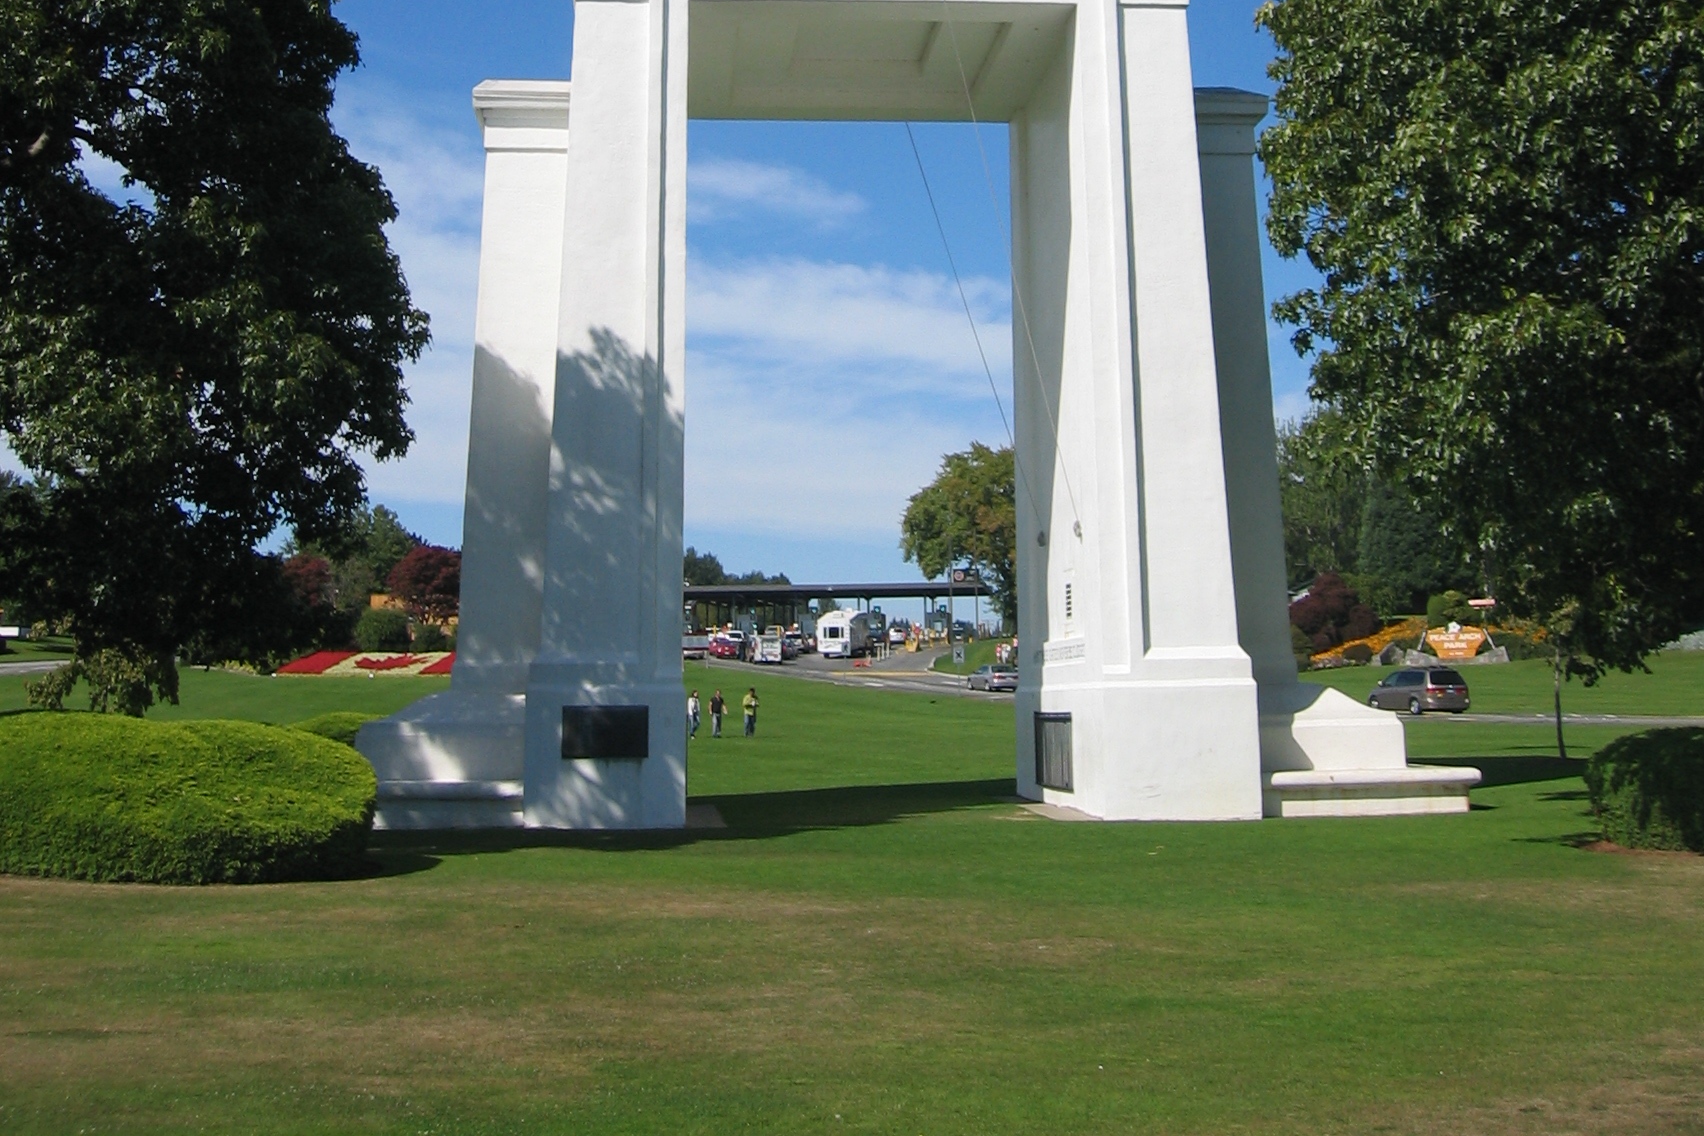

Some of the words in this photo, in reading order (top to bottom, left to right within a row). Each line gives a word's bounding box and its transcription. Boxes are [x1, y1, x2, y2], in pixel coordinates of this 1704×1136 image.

[1429, 633, 1455, 641] PEACE
[1459, 632, 1482, 640] ARCH
[1443, 641, 1468, 649] PARK
